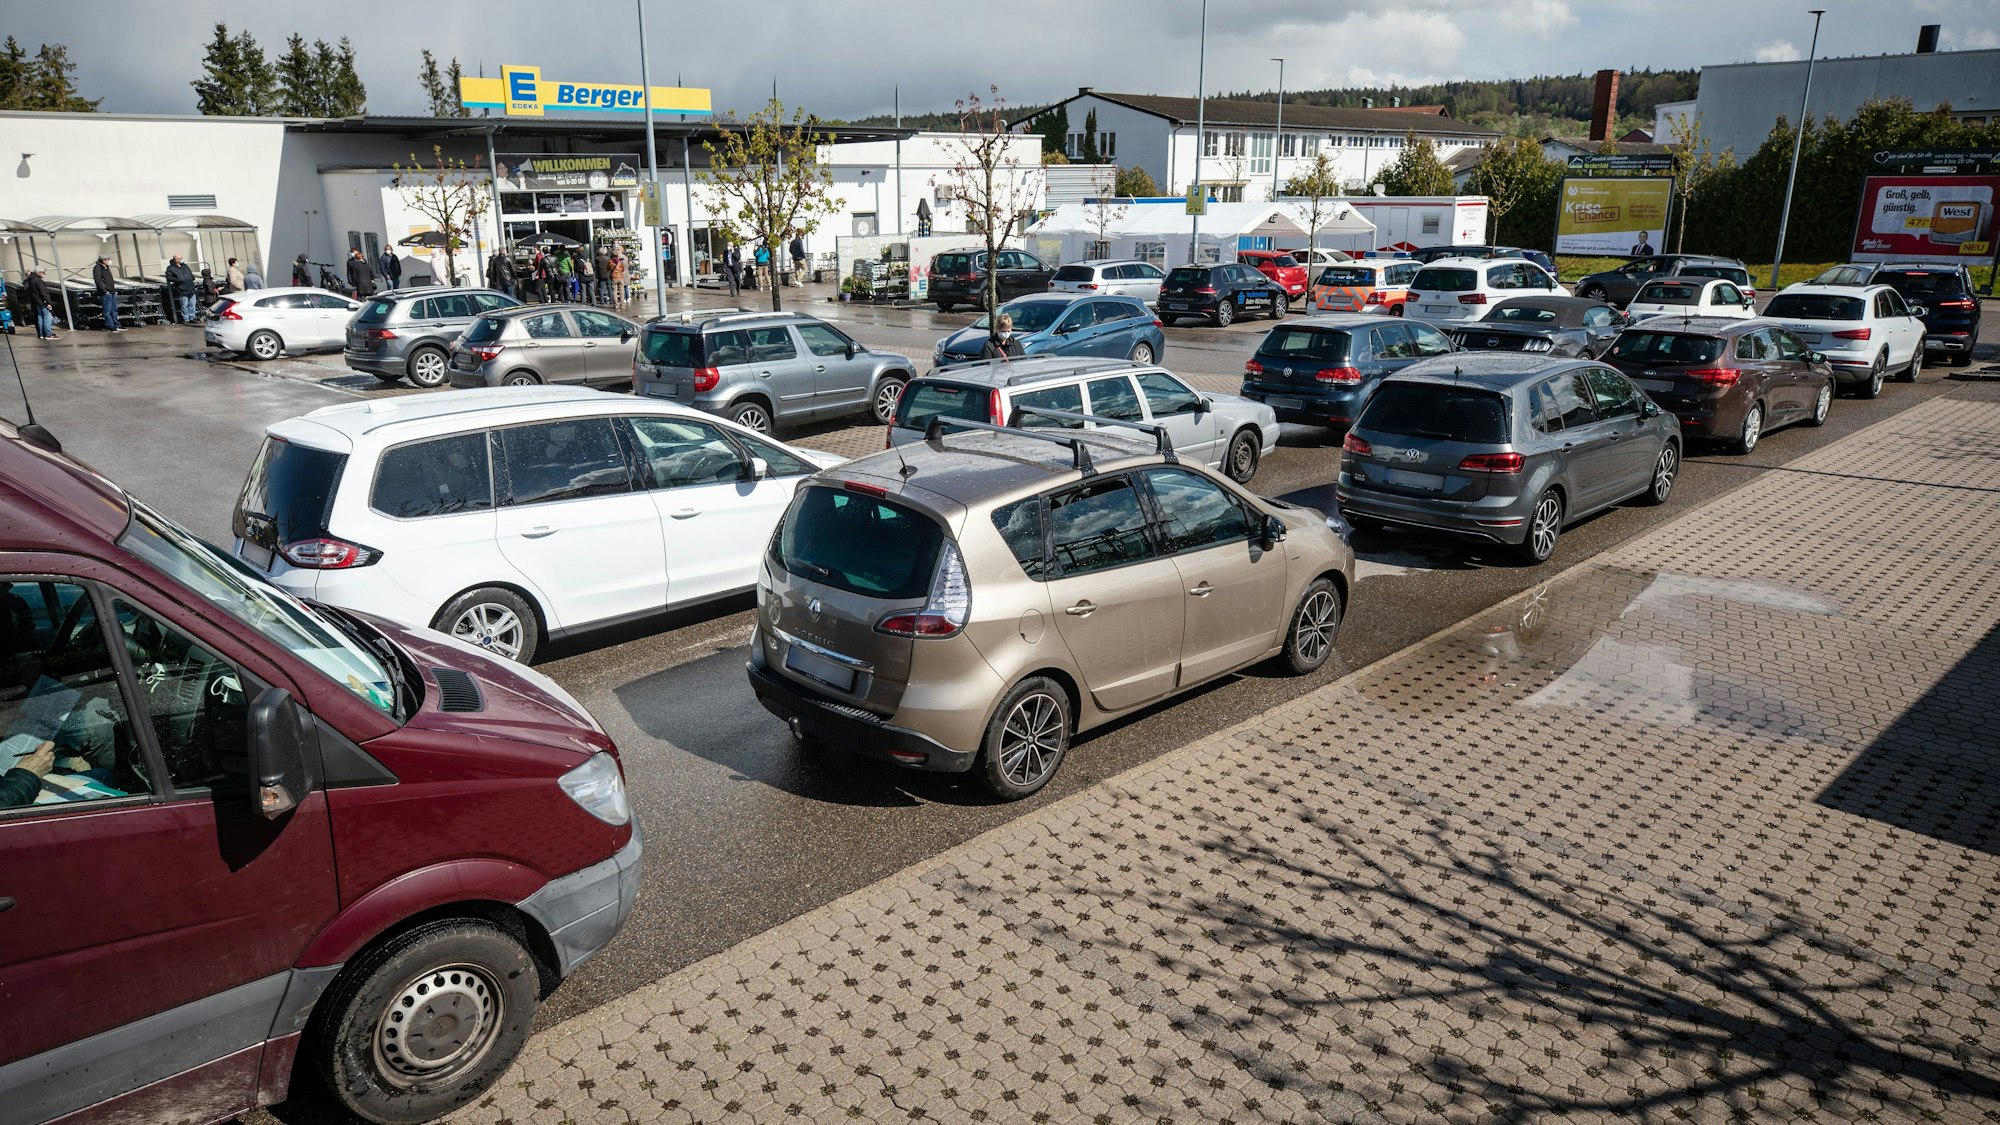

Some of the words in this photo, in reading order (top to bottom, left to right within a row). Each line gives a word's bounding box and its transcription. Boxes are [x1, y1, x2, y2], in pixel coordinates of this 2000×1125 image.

[509, 72, 537, 101] E
[557, 84, 643, 109] Berger
[532, 158, 611, 172] WILLKOMMEN
[1192, 186, 1199, 196] P
[1885, 190, 1909, 201] Groß,
[1910, 190, 1932, 201] gelb,
[1565, 201, 1601, 214] Krise
[1882, 203, 1917, 214] günstig.
[1943, 207, 1971, 216] West
[1578, 210, 1616, 220] Chance
[919, 280, 926, 290] E
[794, 627, 835, 648] SCENIC
